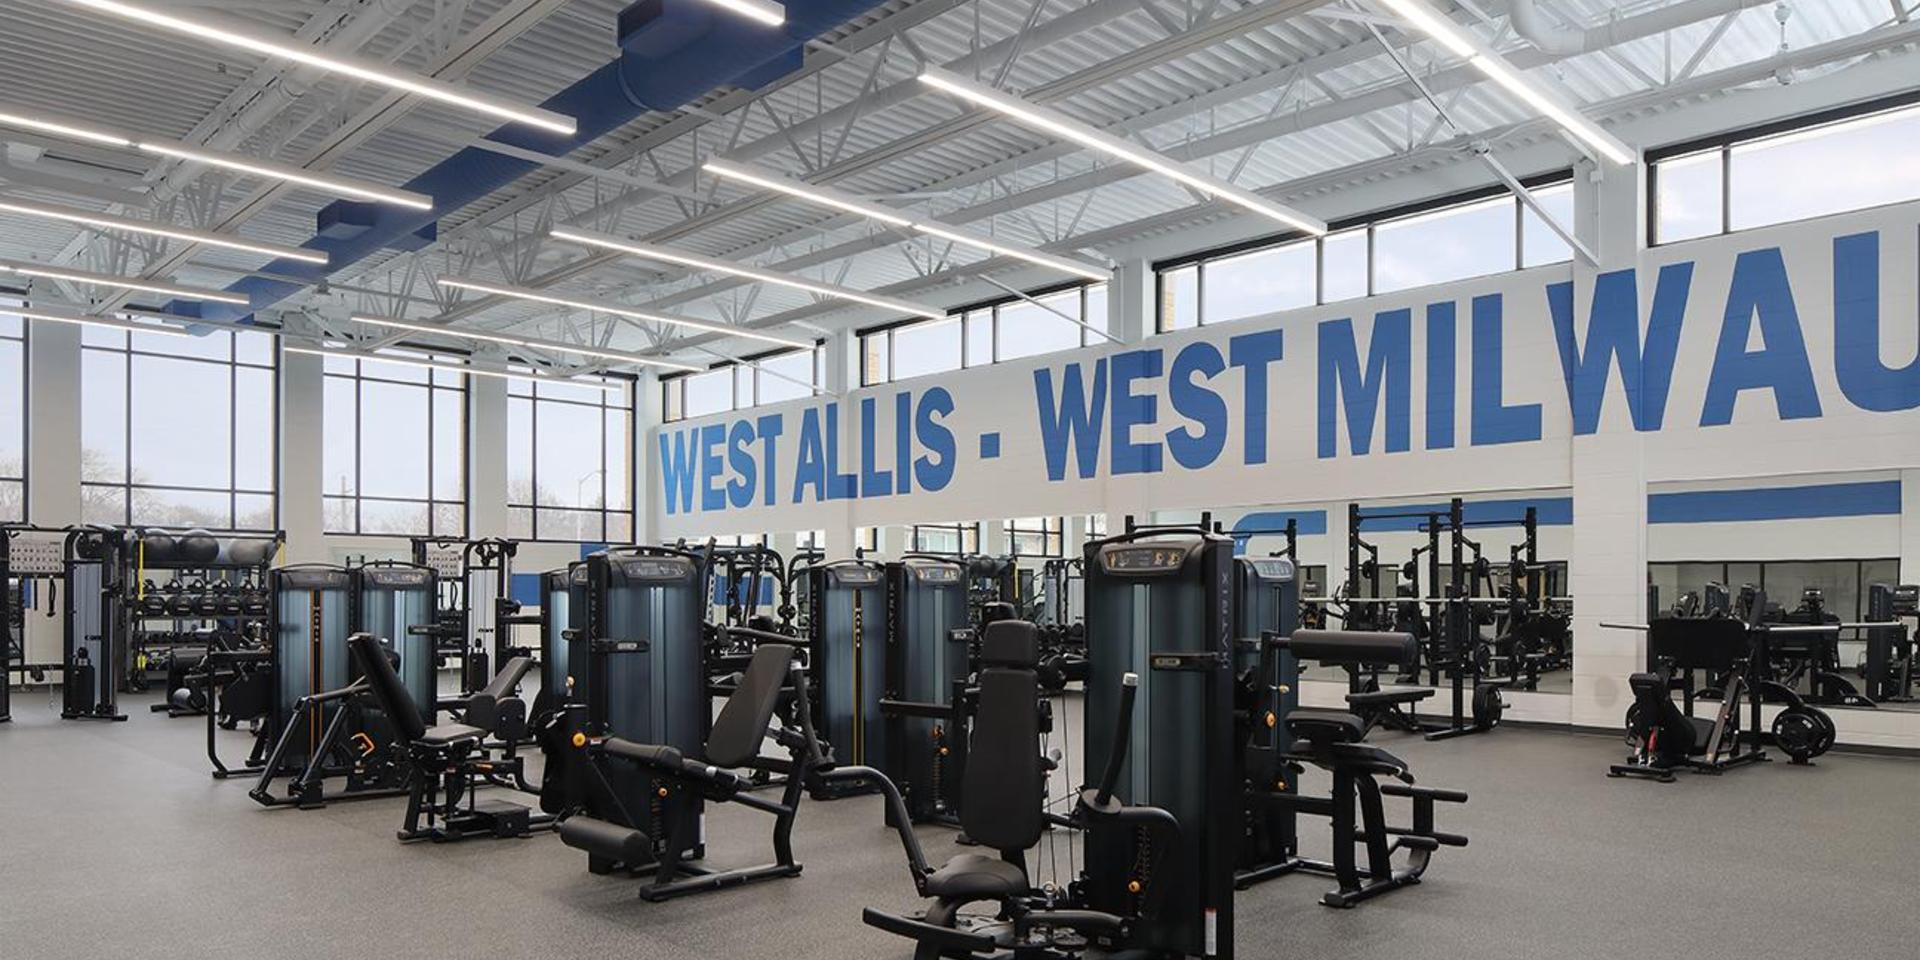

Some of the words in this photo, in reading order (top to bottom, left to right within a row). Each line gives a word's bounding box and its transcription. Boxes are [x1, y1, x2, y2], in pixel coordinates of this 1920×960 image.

[659, 413, 783, 515] WEST
[792, 386, 957, 504] ALLIS
[1033, 328, 1283, 482] WEST
[1221, 572, 1230, 670] MATRIX
